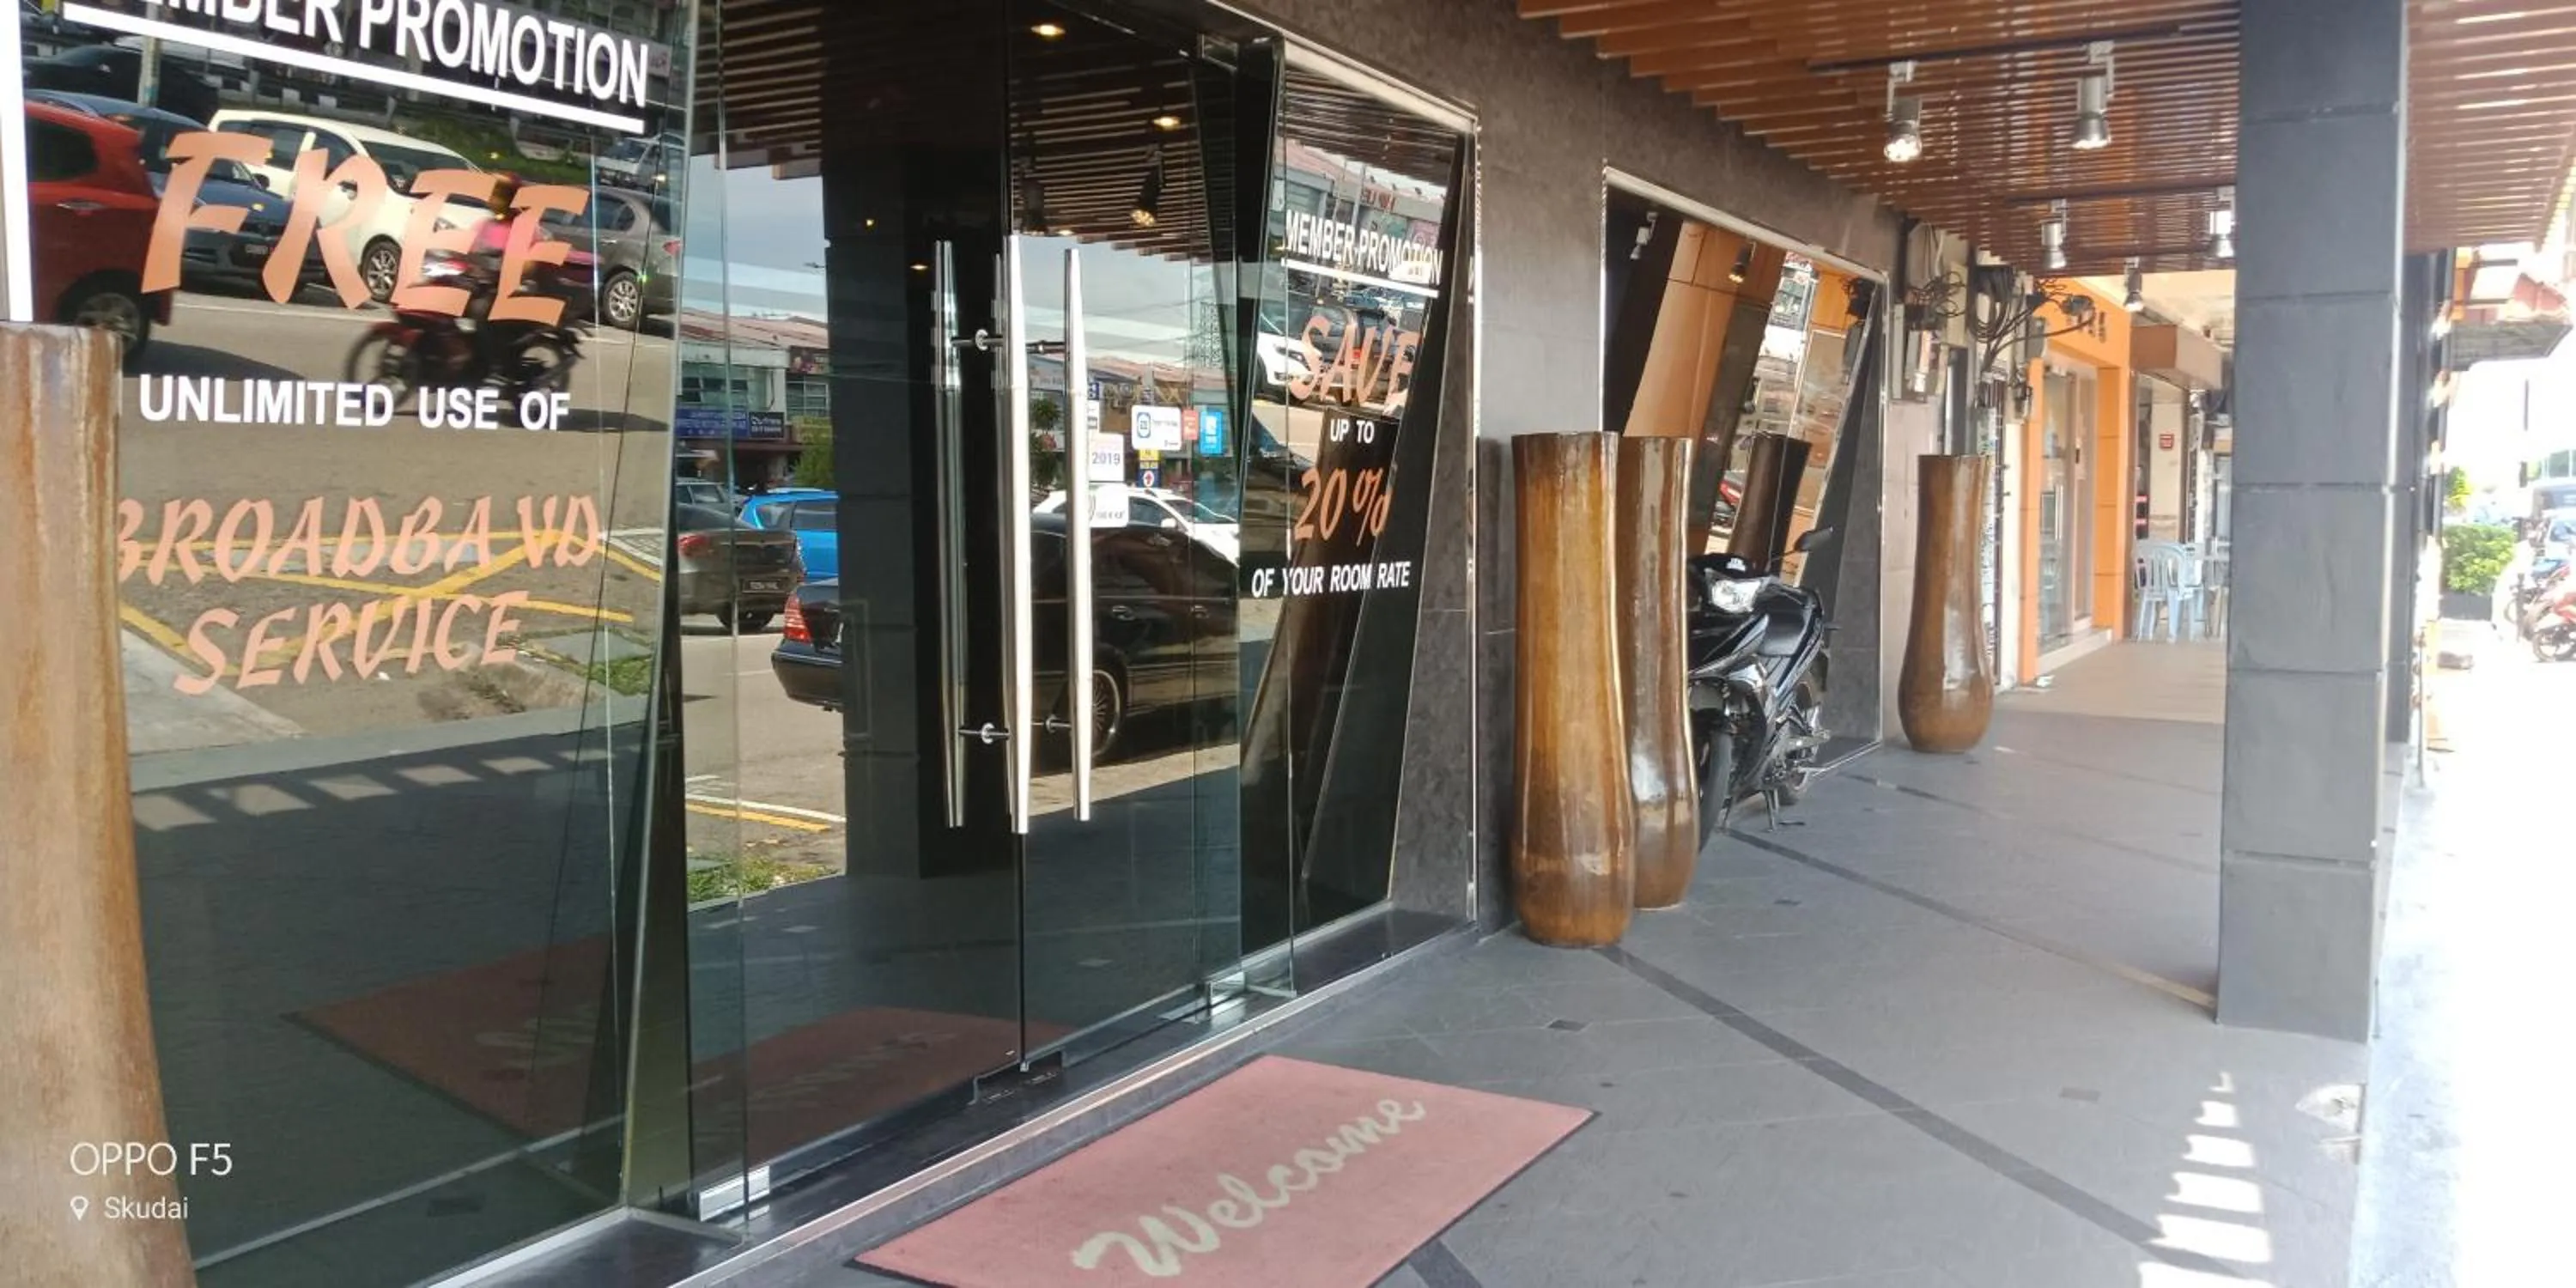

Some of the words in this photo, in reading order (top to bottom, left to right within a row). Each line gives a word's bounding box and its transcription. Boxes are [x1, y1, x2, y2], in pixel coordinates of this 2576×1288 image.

[359, 0, 648, 107] PROMOTION
[142, 131, 589, 326] FREE
[1286, 209, 1355, 264] MEMBER
[1358, 228, 1443, 285] PROMOTION
[140, 374, 395, 427] UNLIMITED
[419, 387, 499, 429] USE
[519, 392, 570, 431] OF
[1291, 315, 1421, 416] SAVE
[1091, 452, 1121, 465] 2019
[1330, 419, 1350, 442] UP
[1357, 421, 1375, 444] TO
[1251, 568, 1275, 598] OF
[1282, 566, 1324, 595] YOUR
[1329, 563, 1371, 592] ROOM
[1376, 562, 1411, 588] RATE
[174, 591, 528, 695] SERVICE
[1072, 1099, 1426, 1276] Welcome
